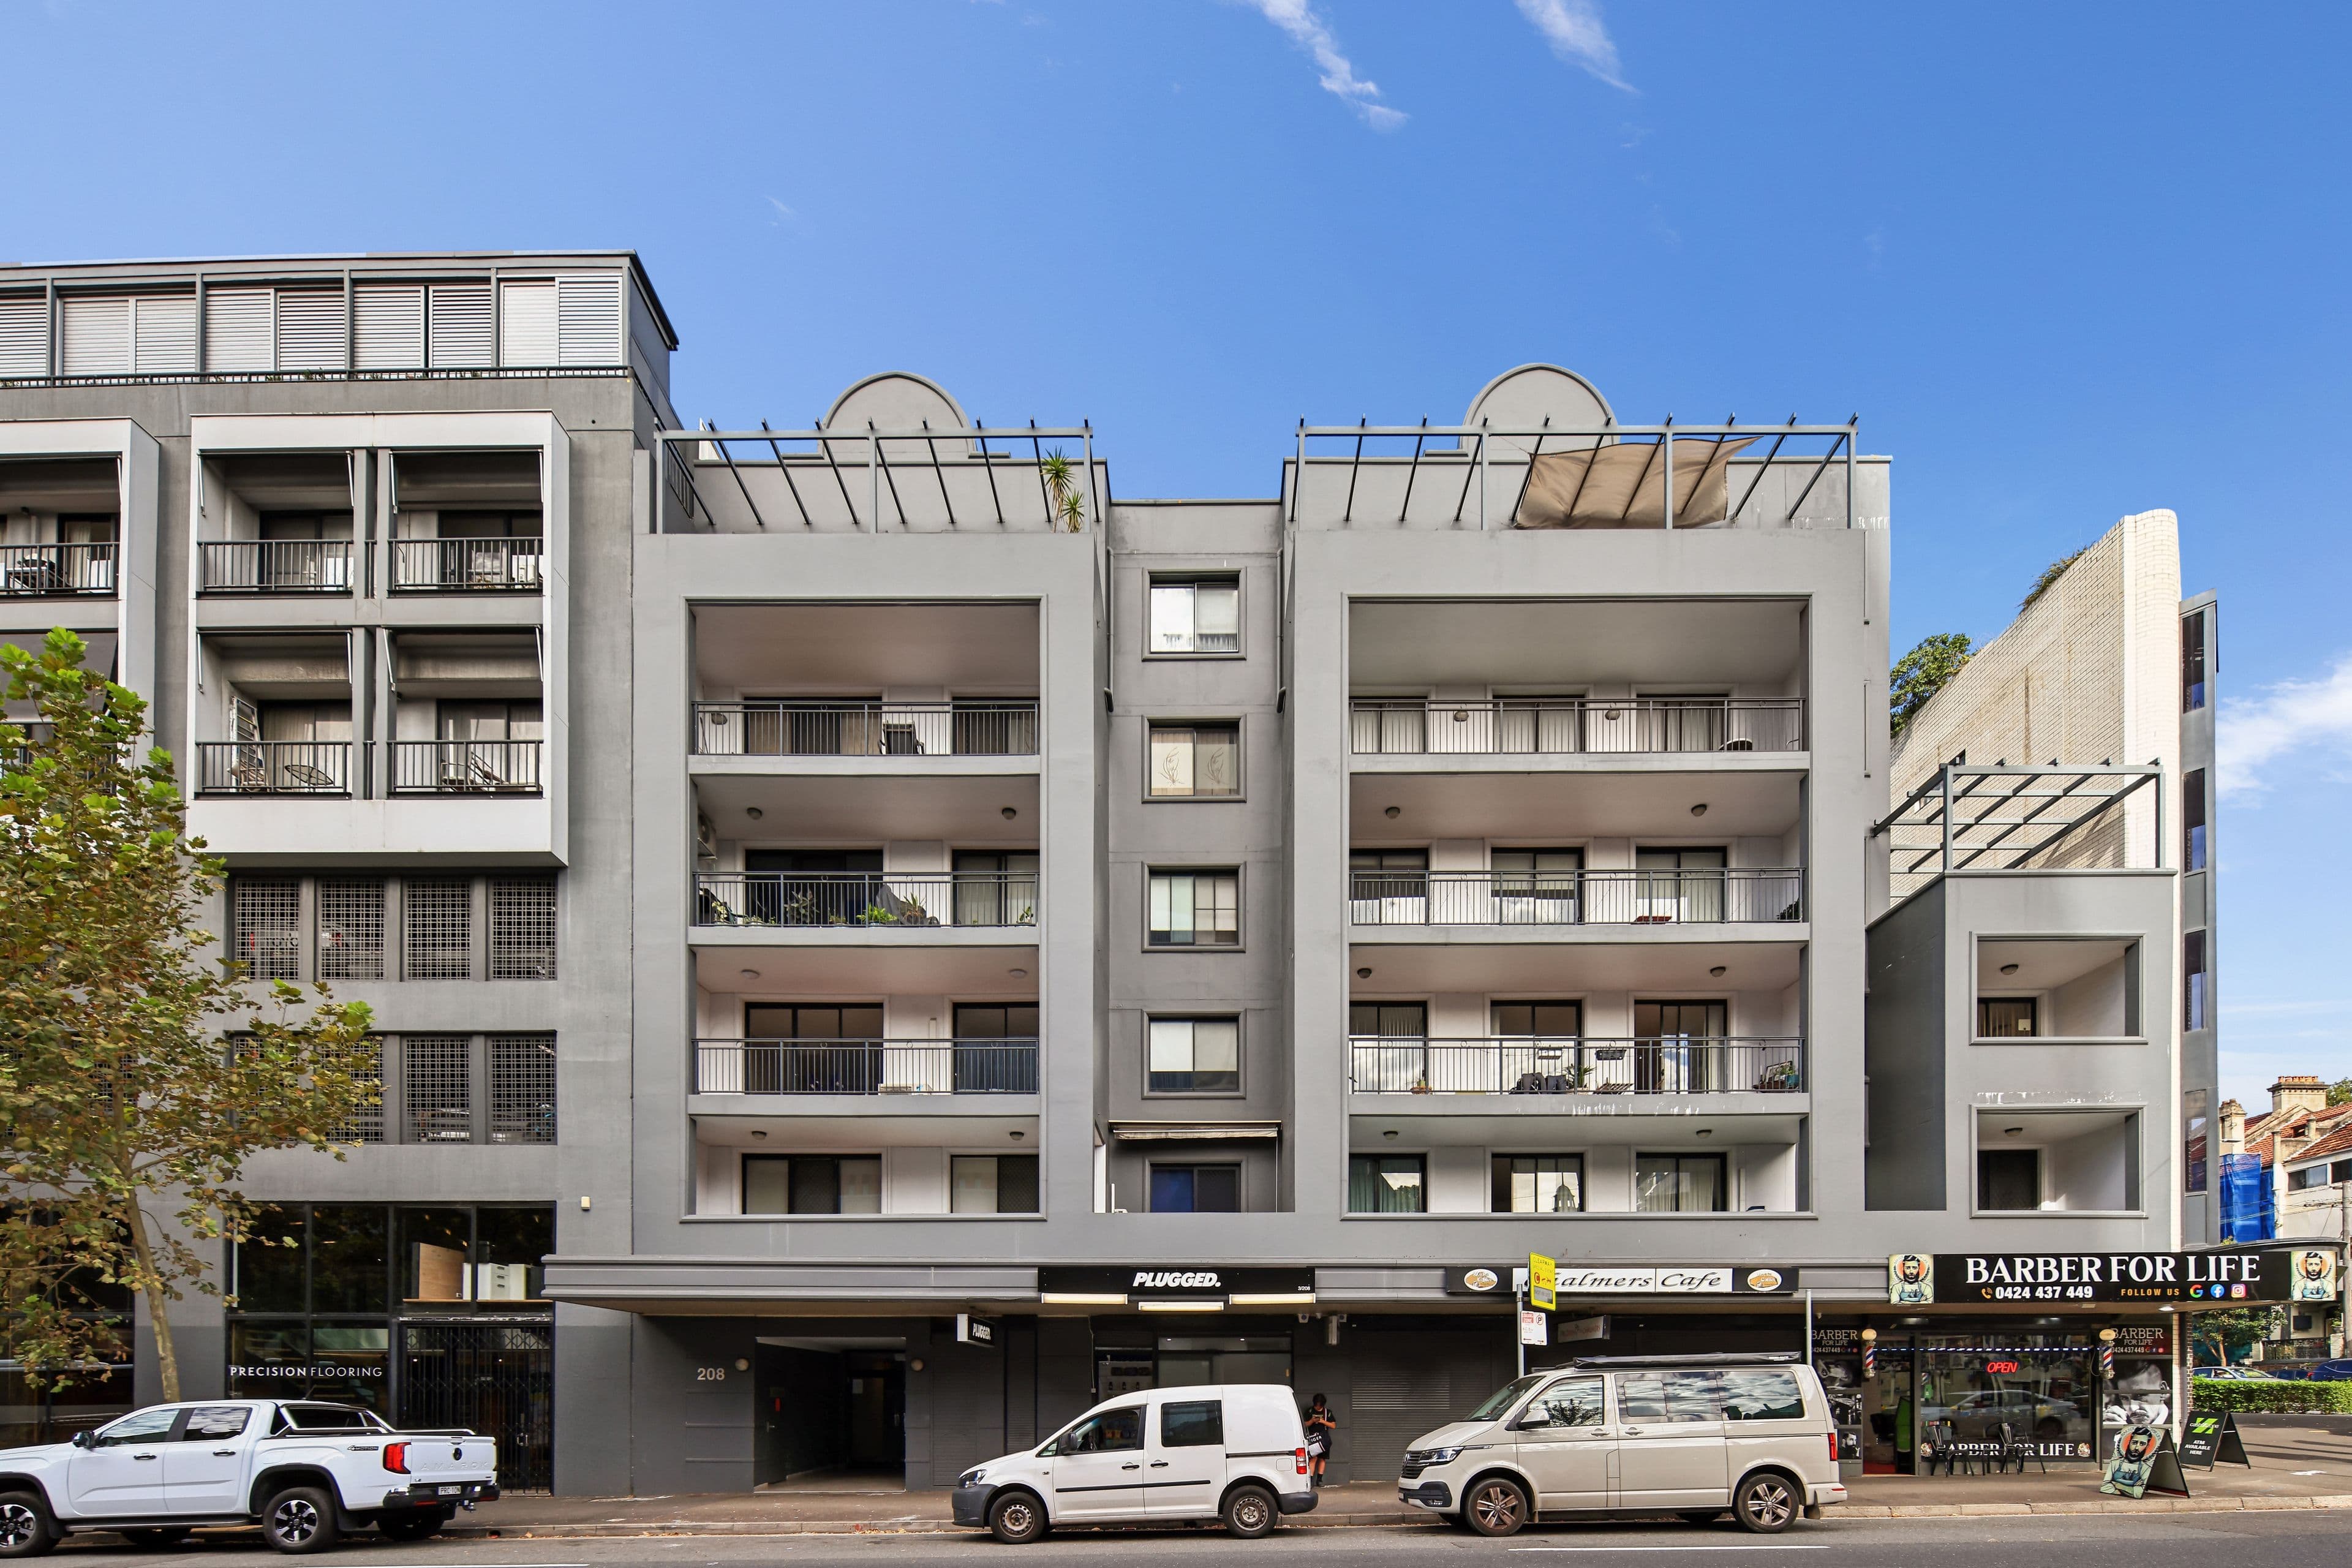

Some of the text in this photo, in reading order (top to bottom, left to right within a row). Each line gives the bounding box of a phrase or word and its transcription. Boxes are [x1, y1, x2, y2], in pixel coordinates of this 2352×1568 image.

[1966, 1256, 2260, 1284] BARBER FOR LIFE
[1133, 1272, 1221, 1287] PLUGGED.
[1523, 1272, 1721, 1291] almers Cafe
[1995, 1286, 2093, 1299] 0424 437 449
[1812, 1330, 1858, 1340] BARBER
[2111, 1328, 2164, 1339] BARBER
[230, 1366, 383, 1377] PRECISION FLOORING
[1987, 1362, 2018, 1373] OPEN
[697, 1368, 725, 1381] 208
[1938, 1443, 2000, 1456] ARBER
[2039, 1443, 2074, 1456] LIFE
